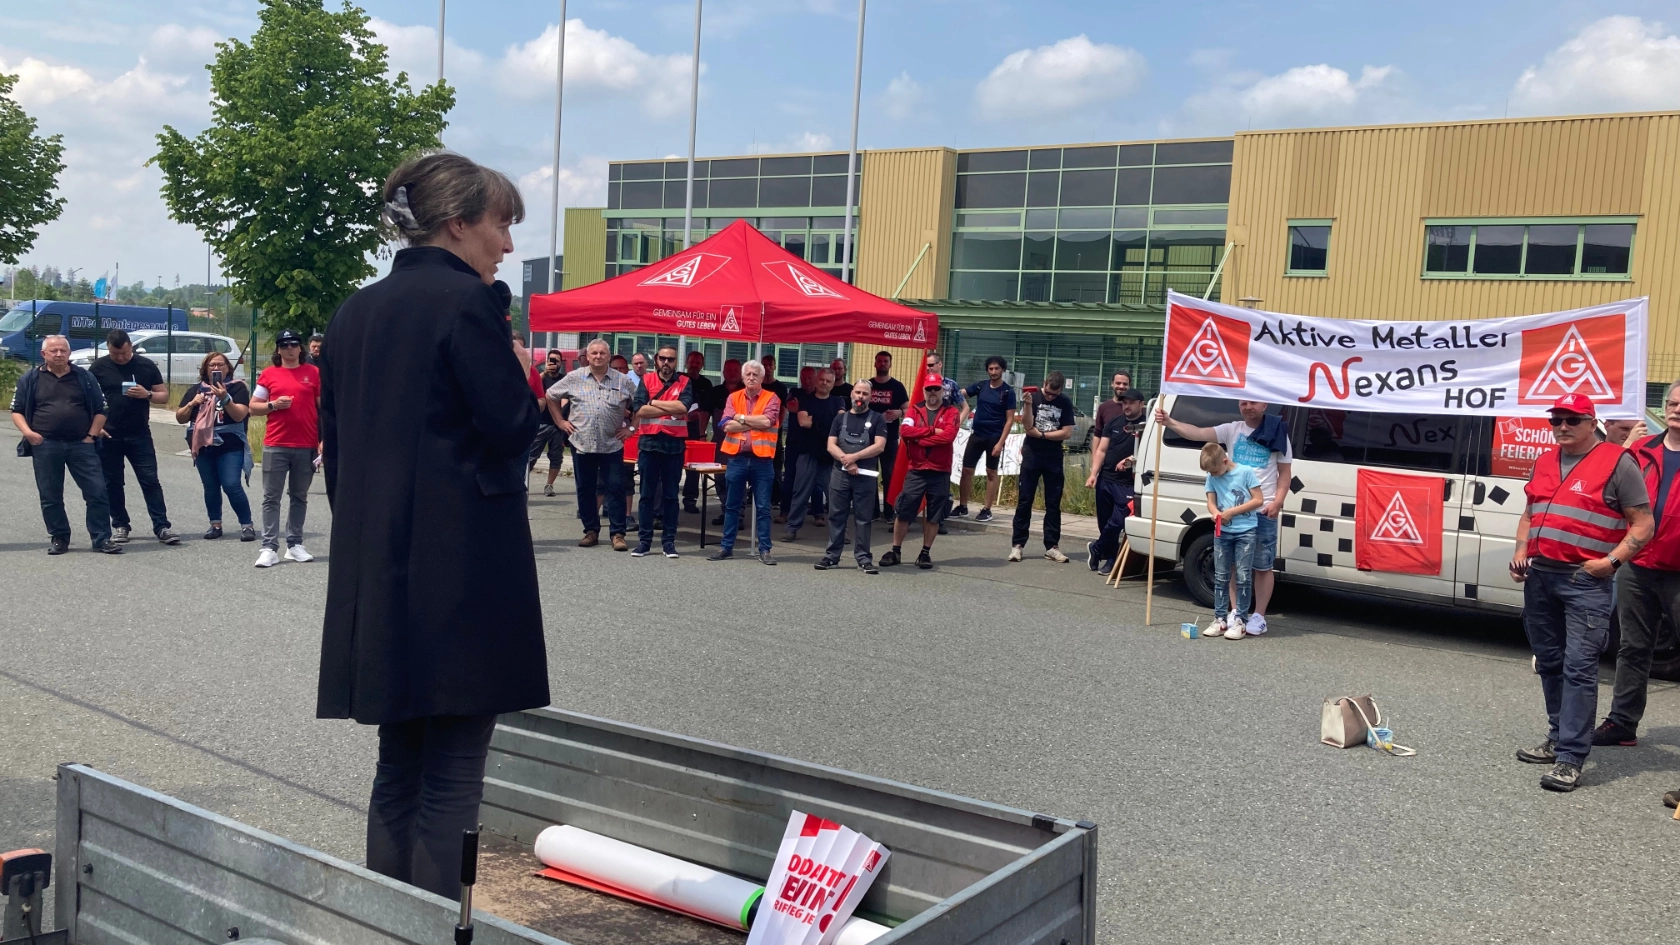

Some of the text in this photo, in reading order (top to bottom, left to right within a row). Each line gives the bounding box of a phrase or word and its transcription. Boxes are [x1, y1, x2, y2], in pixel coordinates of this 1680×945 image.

[652, 308, 717, 321] GEMEINSAM FÜR EIN
[101, 317, 179, 331] Montageservie
[676, 319, 717, 331] GUTES LEBEN
[1254, 319, 1510, 350] Aktive Metaller
[1298, 356, 1459, 402] Nexans
[1443, 387, 1507, 409] HOF
[1515, 427, 1558, 445] SCHÖN
[1500, 443, 1552, 460] FEIERA
